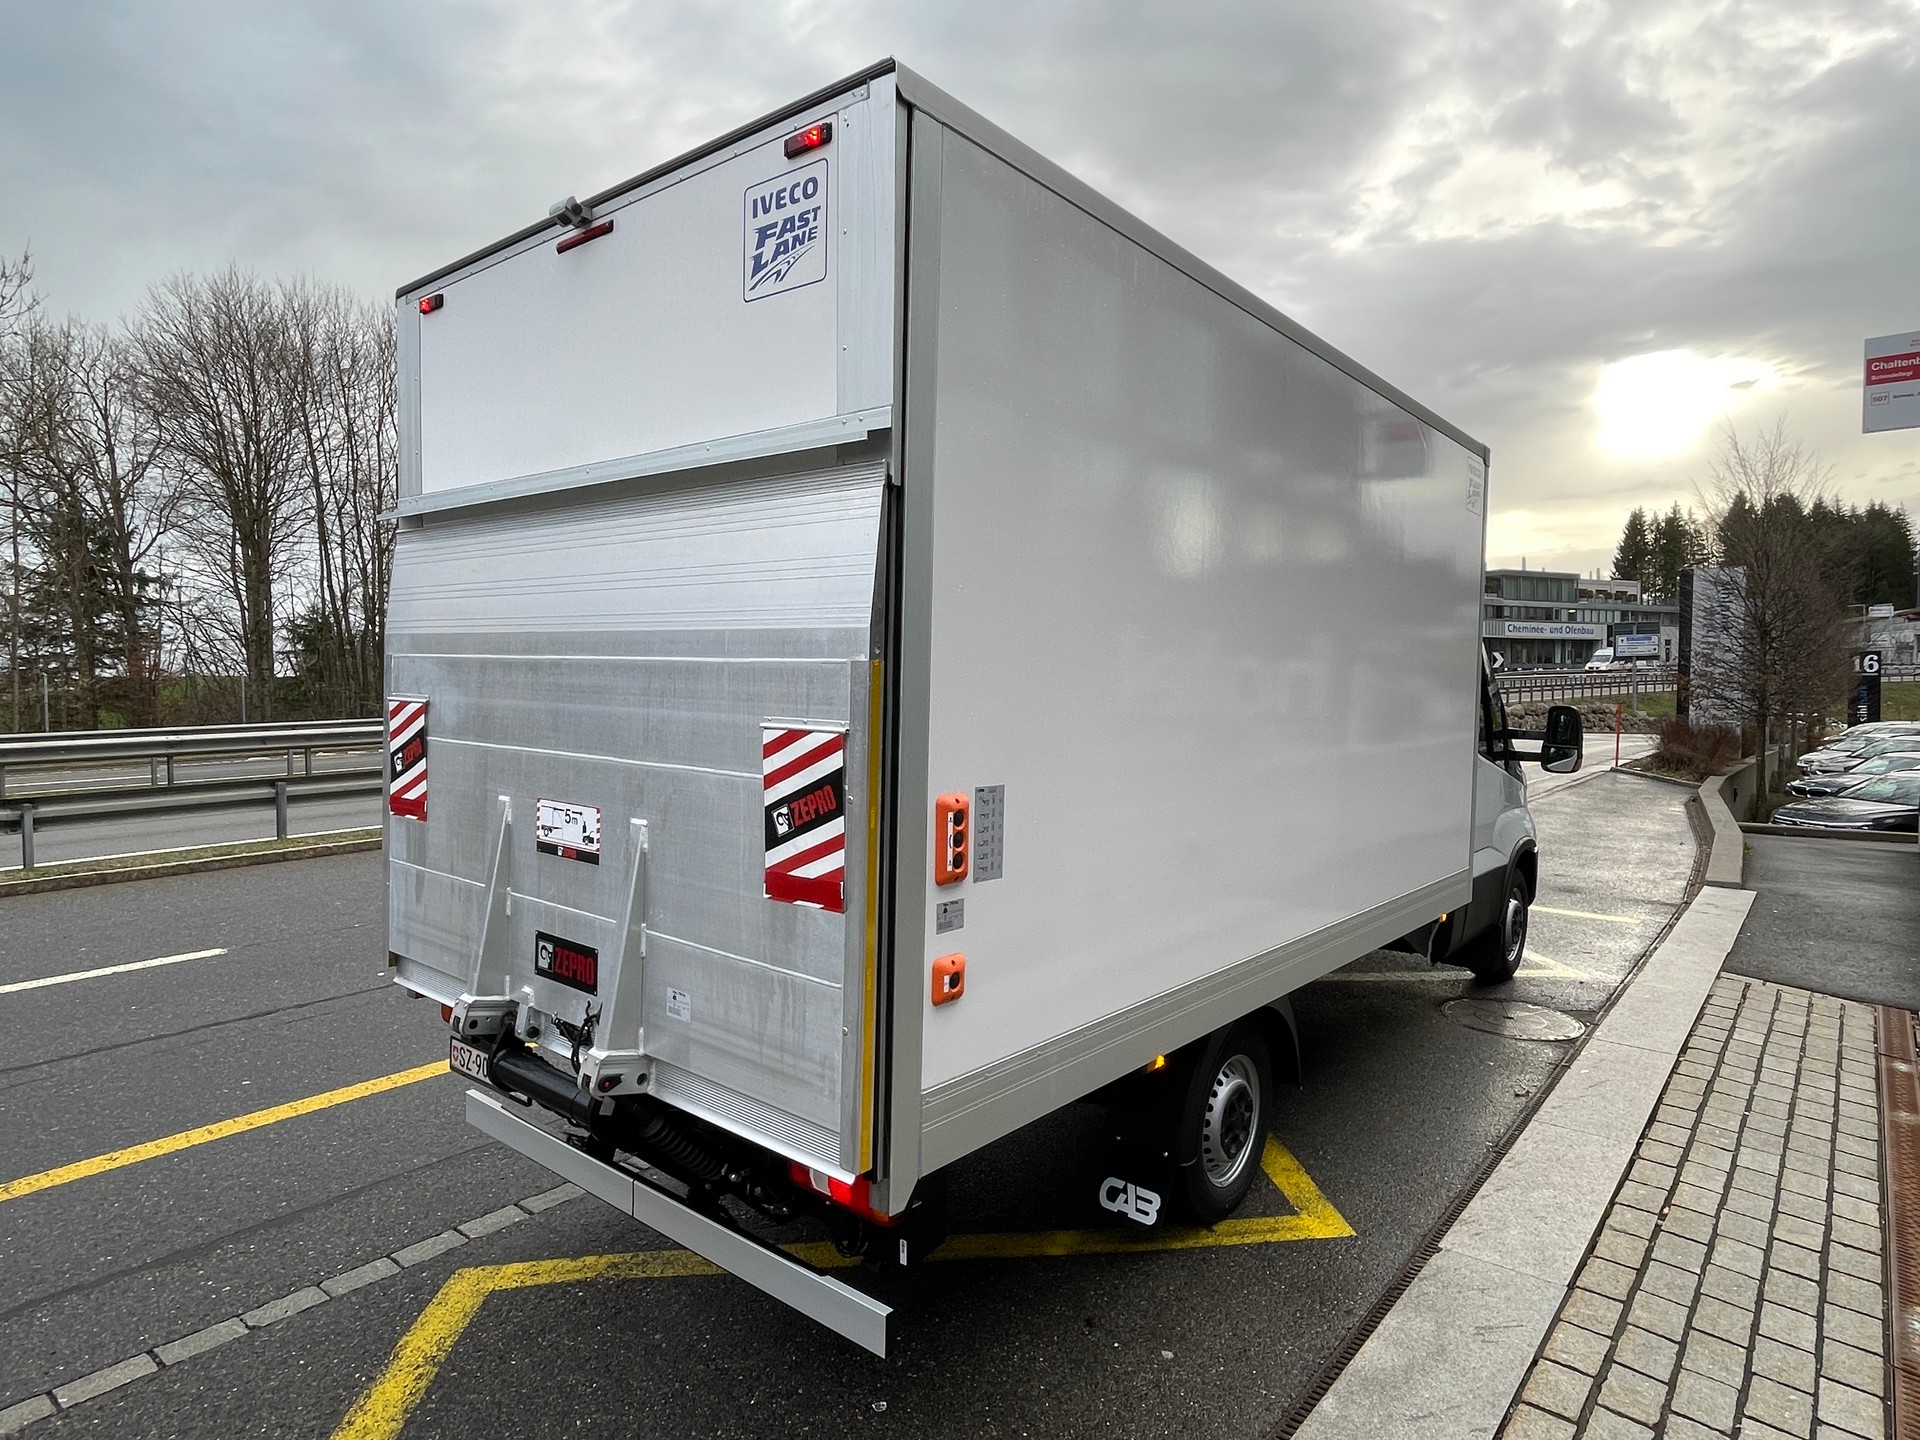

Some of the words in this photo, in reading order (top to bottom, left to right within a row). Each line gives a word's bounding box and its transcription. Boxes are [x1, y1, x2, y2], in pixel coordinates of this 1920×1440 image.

[752, 176, 819, 219] IVECO
[753, 205, 821, 251] FAST
[750, 225, 818, 281] LANE
[1549, 625, 1563, 634] und
[1565, 625, 1594, 635] Ofenbau
[1852, 654, 1879, 673] 16
[789, 784, 837, 827] ZEPRO
[554, 947, 595, 986] ZEPRO
